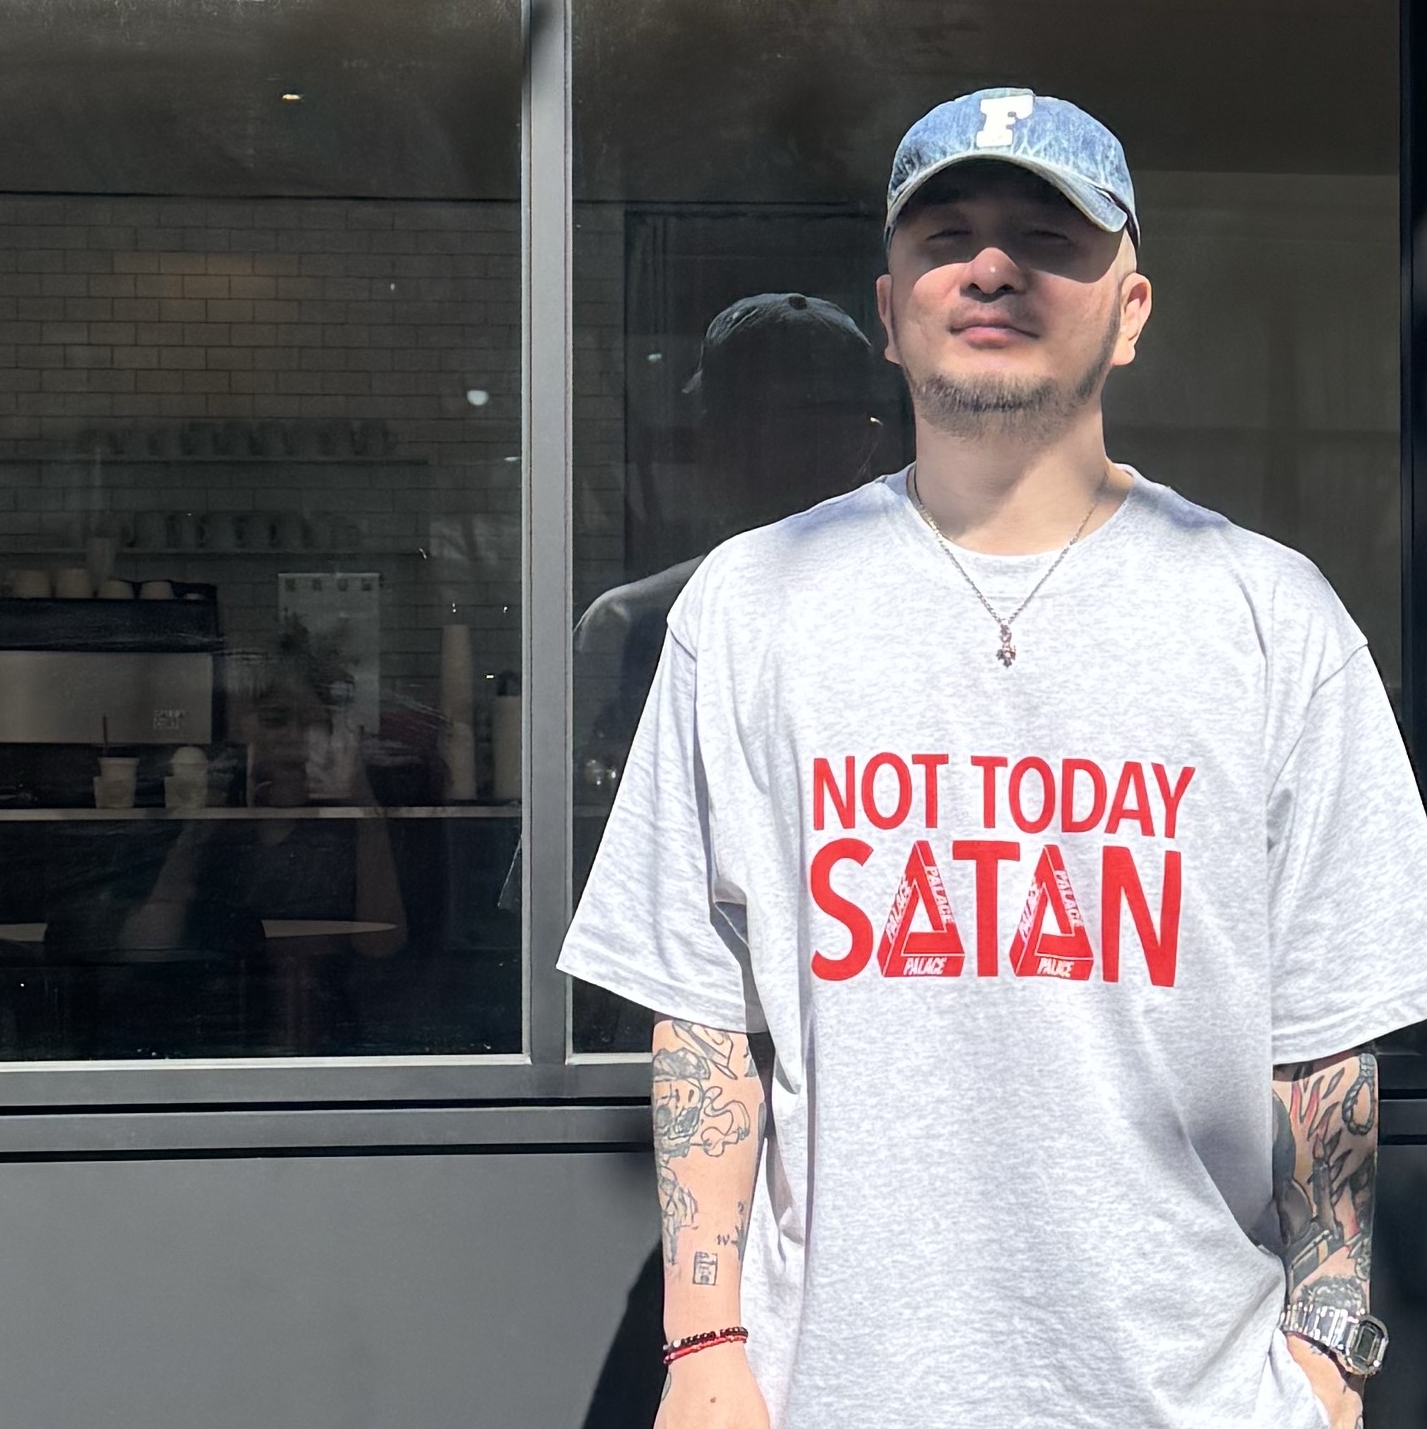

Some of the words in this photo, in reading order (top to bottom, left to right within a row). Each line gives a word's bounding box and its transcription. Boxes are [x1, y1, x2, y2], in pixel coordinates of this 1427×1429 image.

[976, 94, 1035, 148] F
[813, 751, 949, 831] NOT
[970, 755, 1196, 839] TODAY
[810, 837, 1183, 988] SATAN
